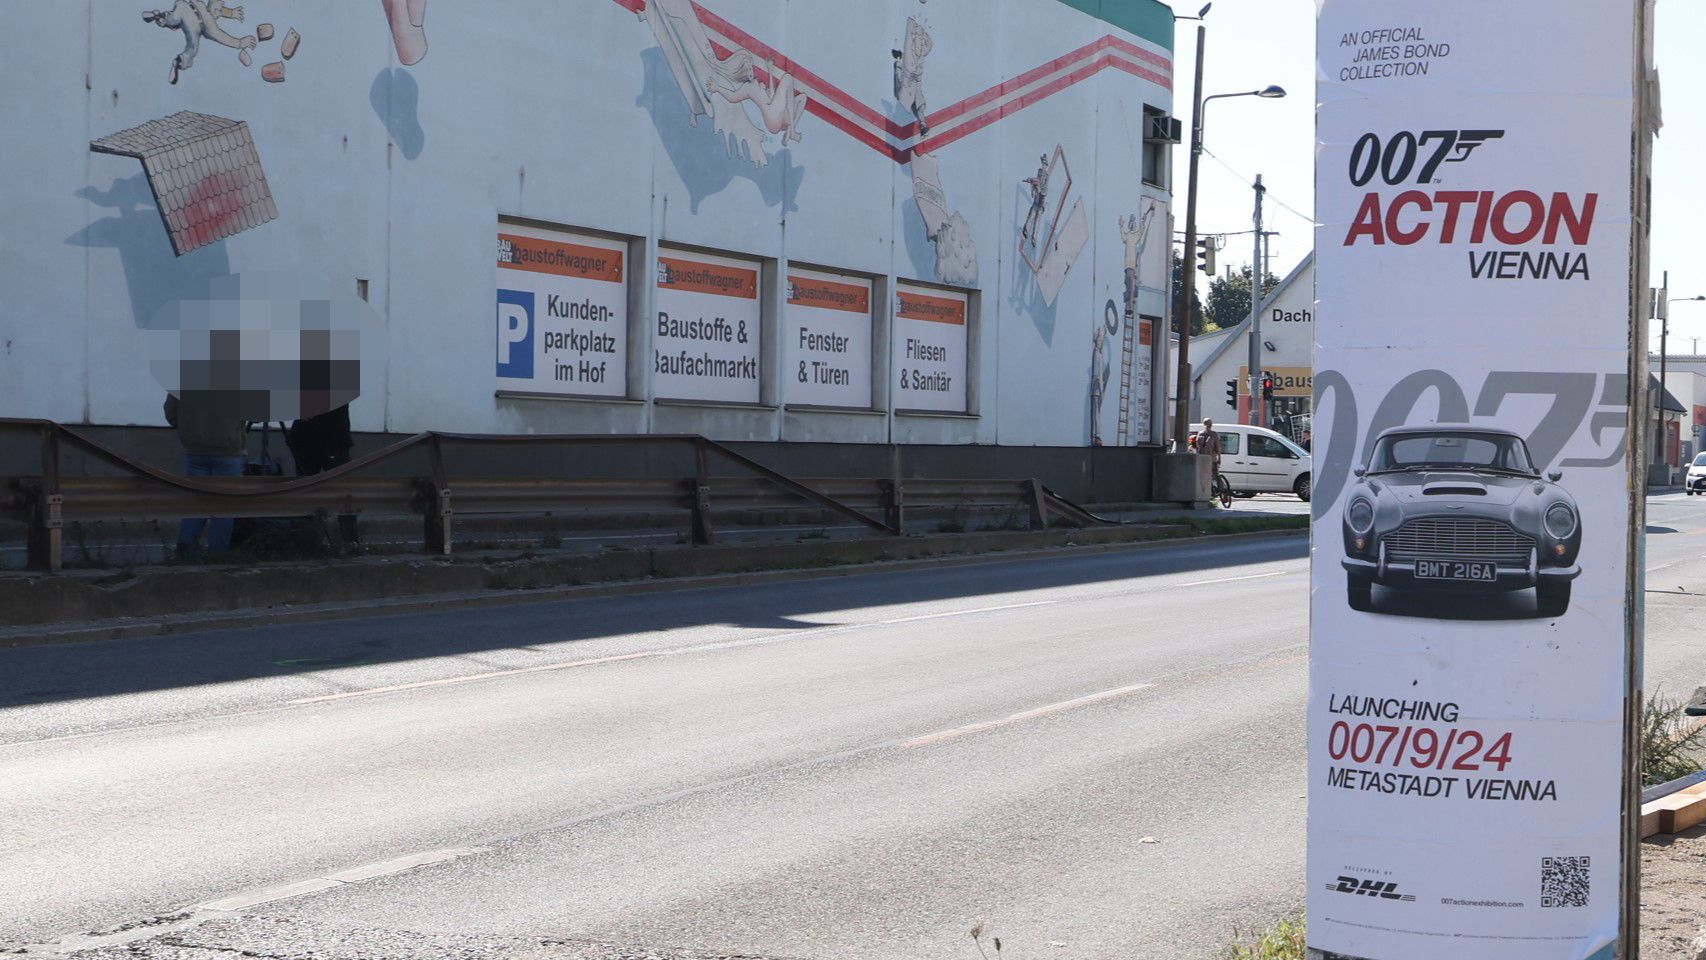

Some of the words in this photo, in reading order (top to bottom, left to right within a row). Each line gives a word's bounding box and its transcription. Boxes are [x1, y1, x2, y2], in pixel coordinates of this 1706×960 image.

[1340, 32, 1359, 47] AN
[1361, 27, 1425, 45] OFFICIAL
[1353, 45, 1401, 63] JAMES
[1404, 43, 1450, 59] BOND
[1340, 61, 1429, 81] COLLECTION
[1349, 130, 1458, 187] 007
[1343, 190, 1598, 247] ACTION
[515, 243, 607, 273] baustoffwagner
[1468, 251, 1590, 281] VIENNA
[548, 294, 614, 322] Kunden-
[1272, 308, 1312, 322] Dach
[498, 302, 529, 364] P
[658, 311, 733, 343] Baustoffe
[737, 320, 748, 344] &
[800, 327, 849, 353] Fenster
[544, 328, 616, 356] parkplatz
[906, 338, 946, 362] Fliesen
[555, 358, 574, 381] im
[579, 360, 606, 383] Hof
[798, 360, 808, 383] &
[812, 361, 849, 386] Türen
[900, 368, 909, 389] &
[912, 369, 952, 392] Sanitär
[1418, 561, 1450, 577] BMT
[1454, 563, 1492, 579] 216A
[1329, 693, 1460, 723] LAUNCHING
[1328, 720, 1513, 772] 007/9/24
[1327, 766, 1459, 798] METASTADT
[1466, 778, 1557, 801] VIENNA
[1336, 875, 1402, 901] DHL
[1441, 897, 1525, 908] 007actionexhibition.com
